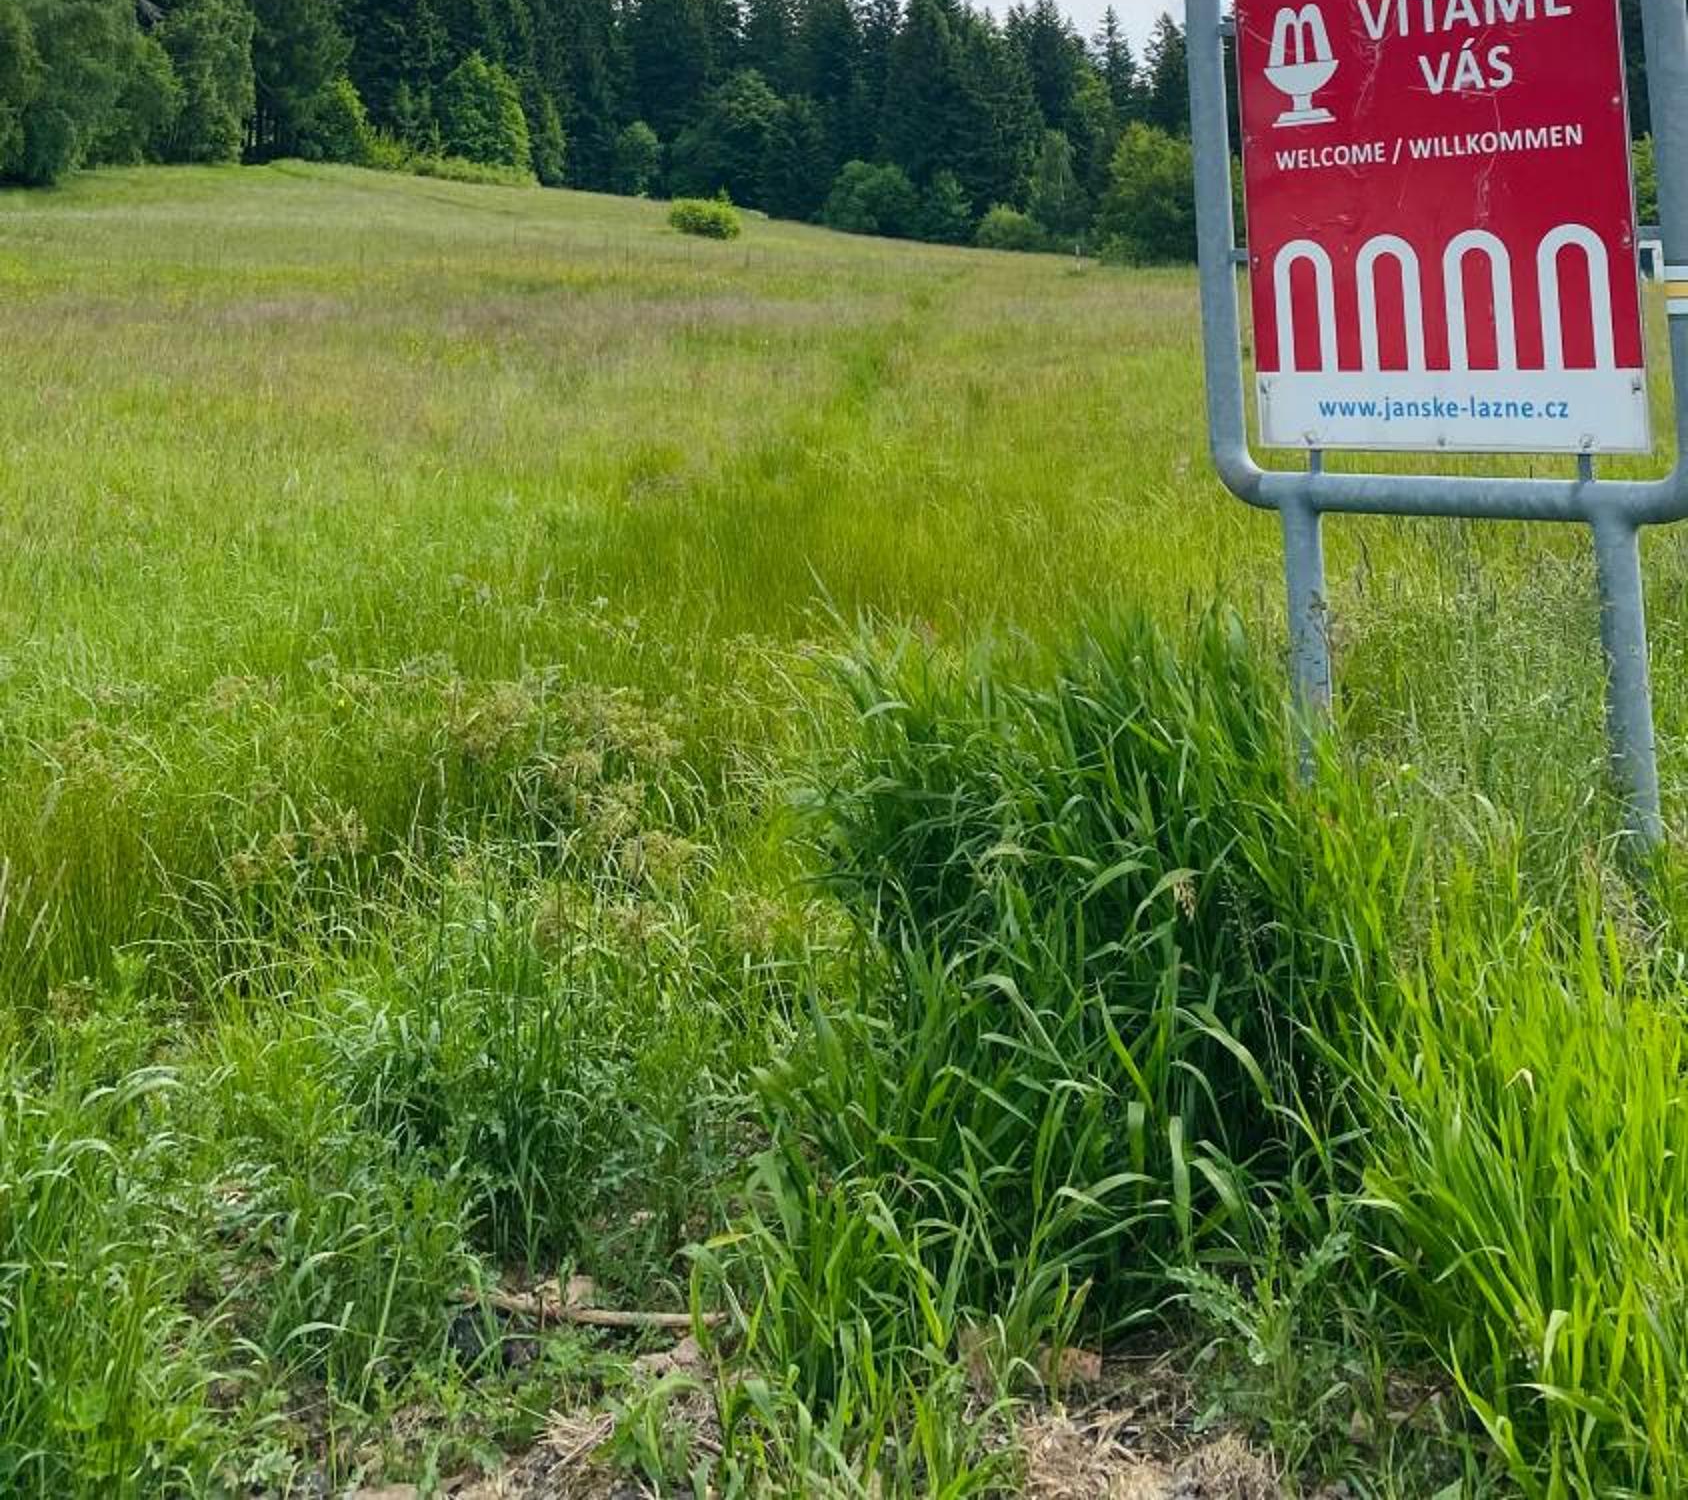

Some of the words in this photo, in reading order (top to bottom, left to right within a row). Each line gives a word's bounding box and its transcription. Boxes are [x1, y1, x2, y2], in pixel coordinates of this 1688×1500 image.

[1418, 37, 1514, 97] VÁS
[1275, 141, 1386, 172] WELCOME
[1409, 123, 1584, 160] WILLKOMMEN
[1318, 396, 1569, 421] www.janske-lazne.cz
